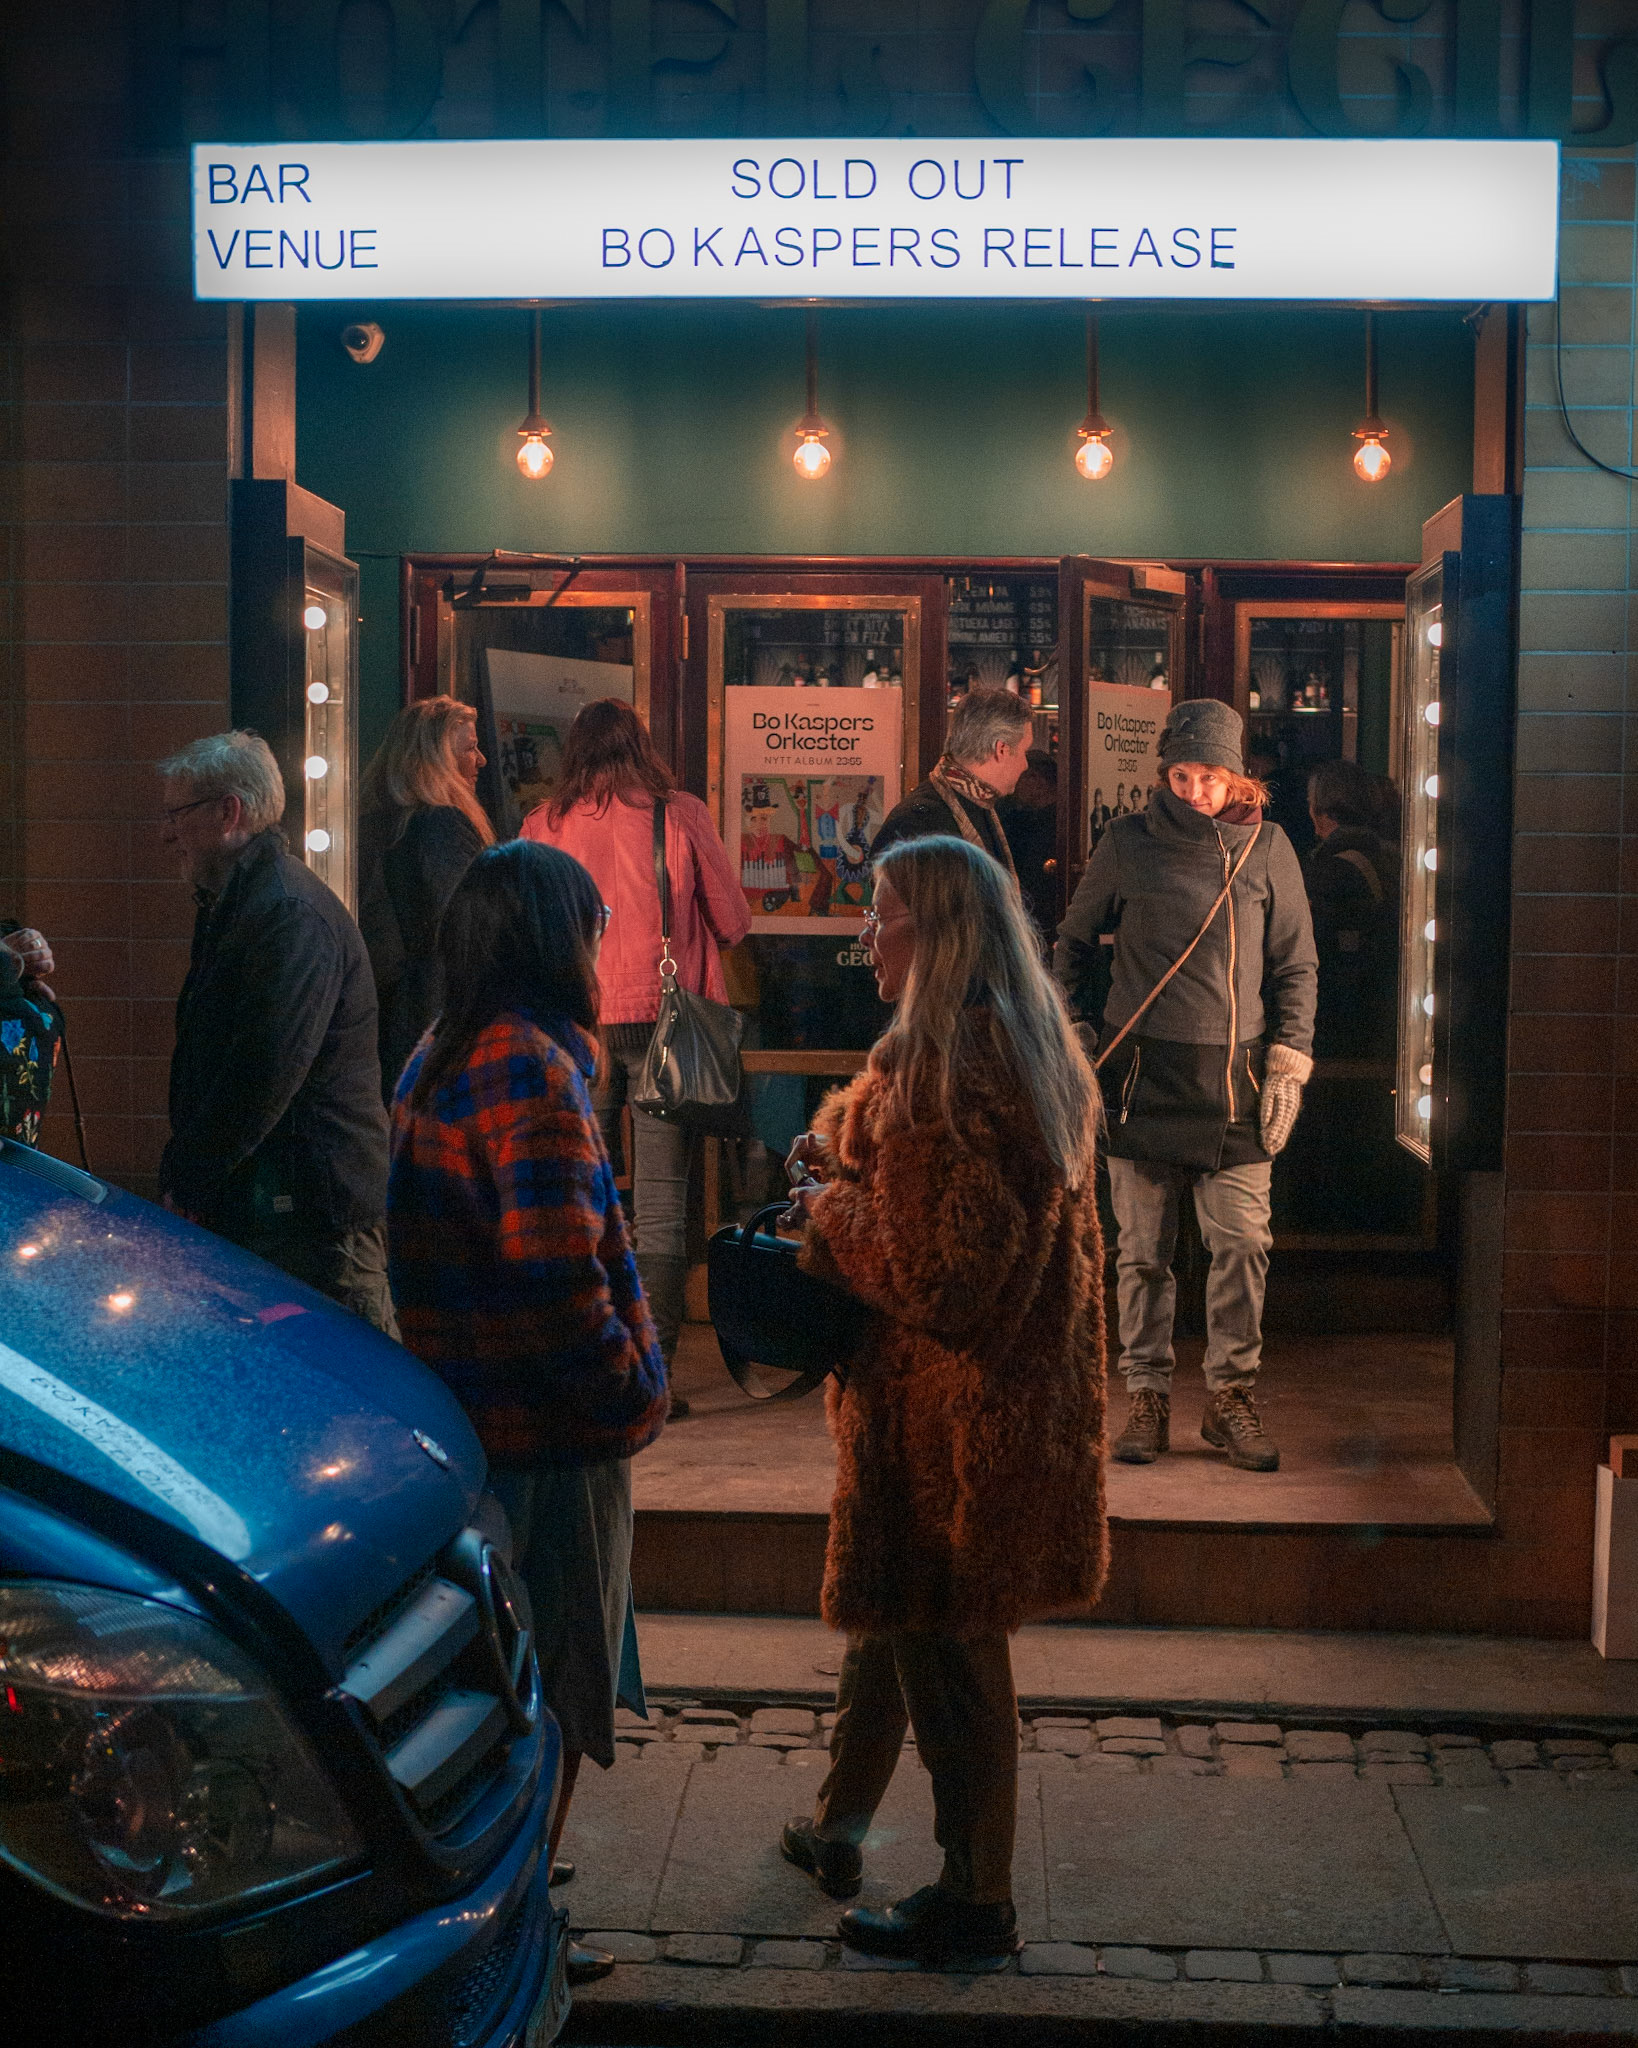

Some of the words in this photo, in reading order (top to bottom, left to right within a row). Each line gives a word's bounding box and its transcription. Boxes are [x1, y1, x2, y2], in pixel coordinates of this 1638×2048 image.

[208, 163, 312, 205] BAR
[731, 158, 877, 200] SOLD
[908, 158, 1024, 200] OUT
[207, 229, 379, 270] VENUE
[602, 228, 676, 268] BO
[694, 227, 961, 268] KASPERS
[983, 227, 1237, 270] RELEASE
[753, 713, 781, 729] Bo
[785, 713, 874, 734] Kaspers
[1097, 712, 1112, 729] Bo
[1114, 714, 1156, 737] Kaspers
[766, 733, 860, 750] Orkester
[1104, 734, 1149, 754] Orkester
[765, 757, 792, 765] NYTT
[794, 757, 833, 765] ALBUM
